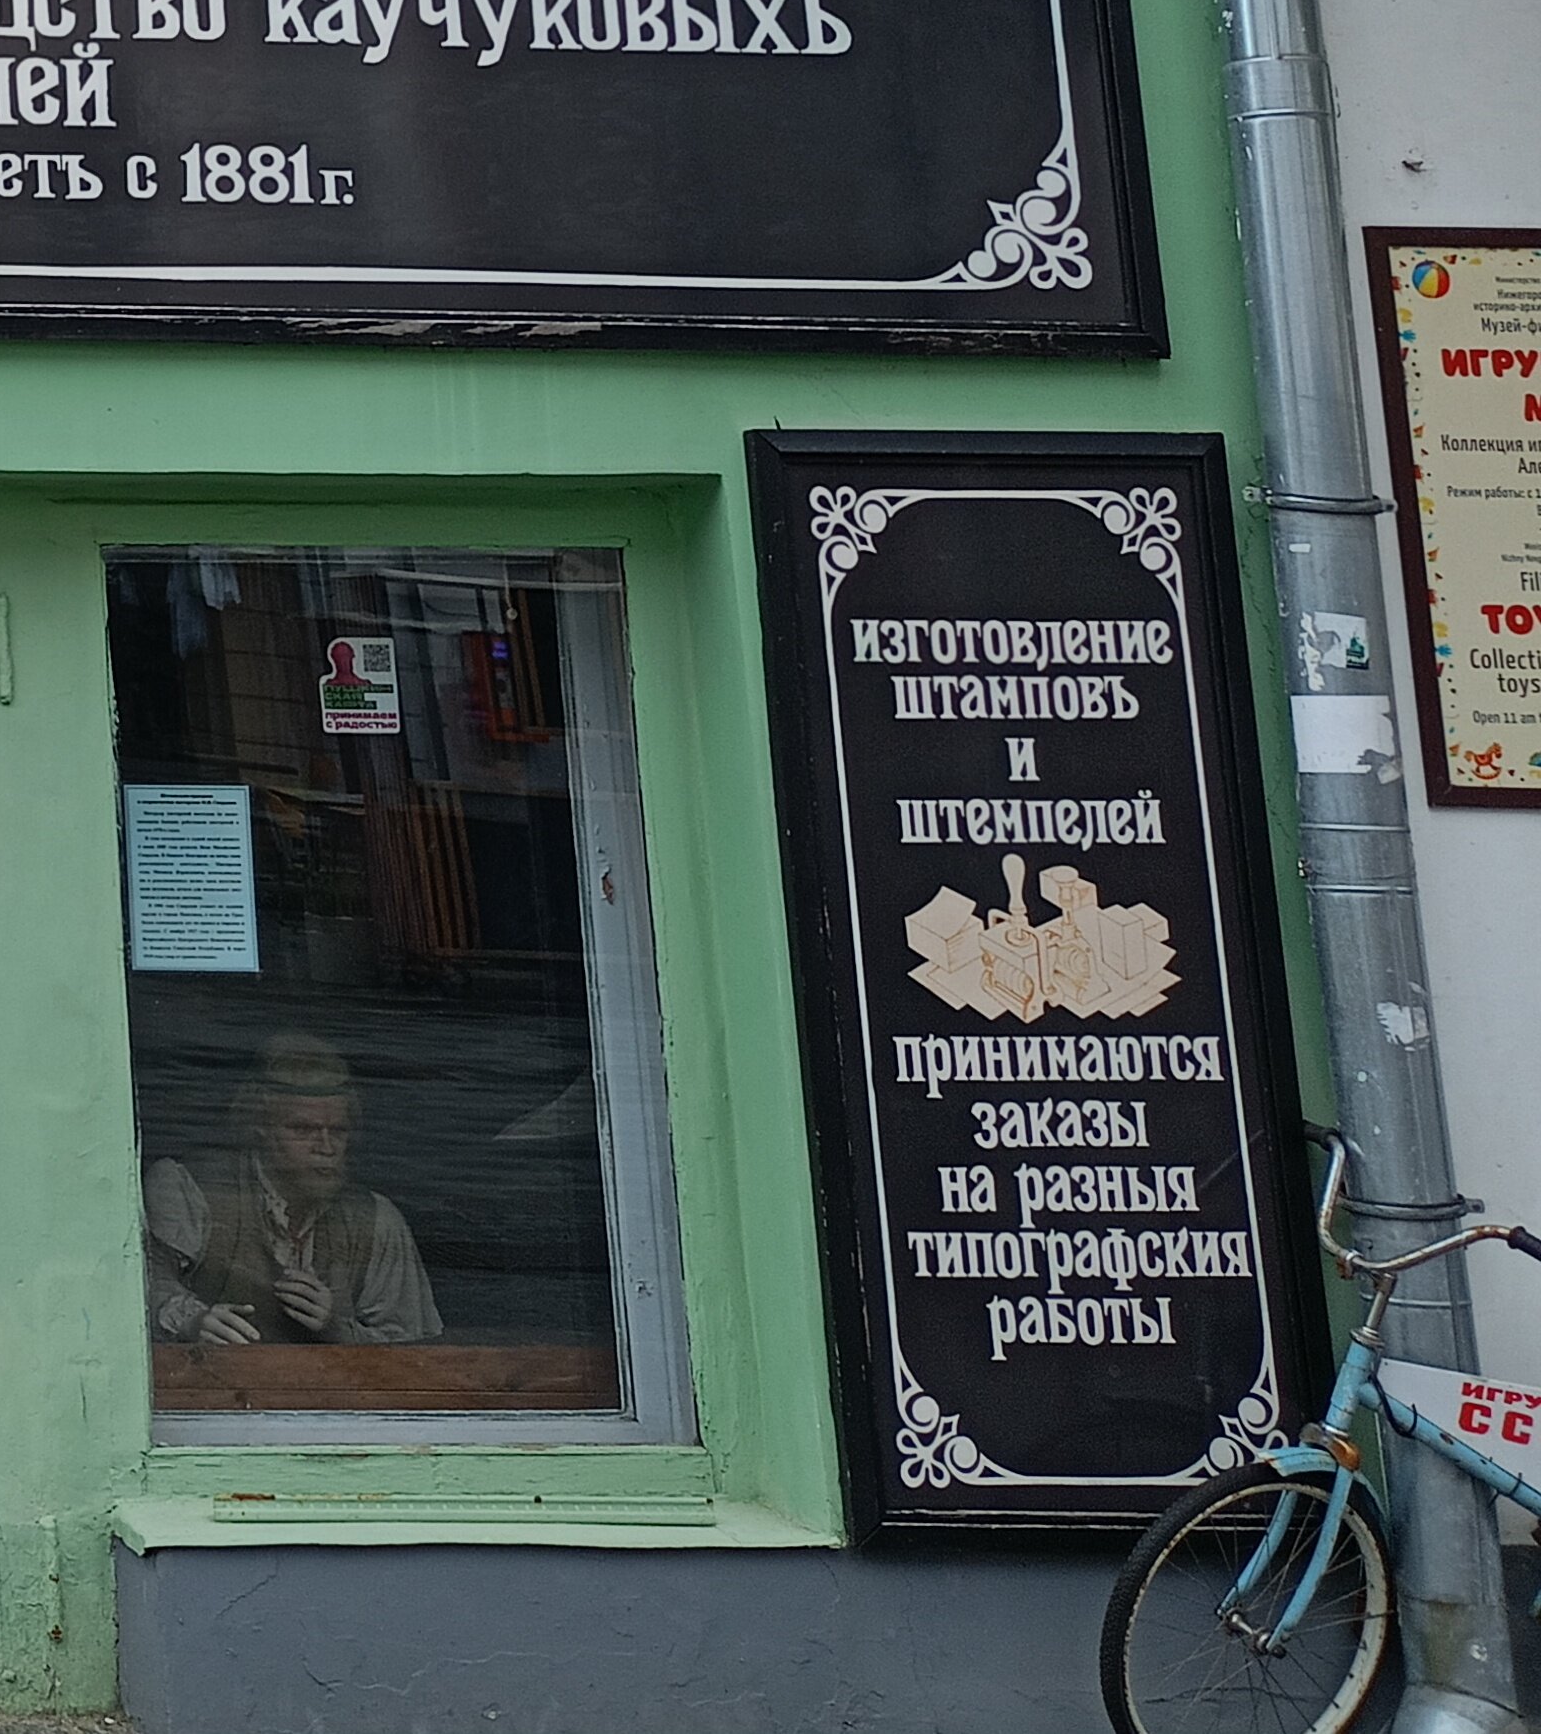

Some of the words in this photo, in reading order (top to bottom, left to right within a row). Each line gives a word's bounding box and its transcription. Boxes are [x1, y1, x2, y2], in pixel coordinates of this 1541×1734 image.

[124, 151, 158, 199] с
[1441, 348, 1538, 378] ИГРУ
[1441, 434, 1524, 455] Коллекция
[1447, 485, 1482, 498] Режим
[851, 615, 1174, 666] изготовление
[892, 673, 1139, 721] штамповъ
[1497, 672, 1541, 698] toys
[1473, 710, 1501, 727] Open
[1006, 736, 1040, 783] и
[897, 787, 1166, 850] штемпелей
[893, 1034, 1225, 1099] принимаются
[972, 1100, 1148, 1150] заказы
[938, 1163, 998, 1215] на
[1016, 1162, 1201, 1232] разныя
[907, 1225, 1253, 1294] типографския
[988, 1292, 1177, 1361] работы
[1461, 1382, 1541, 1410] ИГРУ
